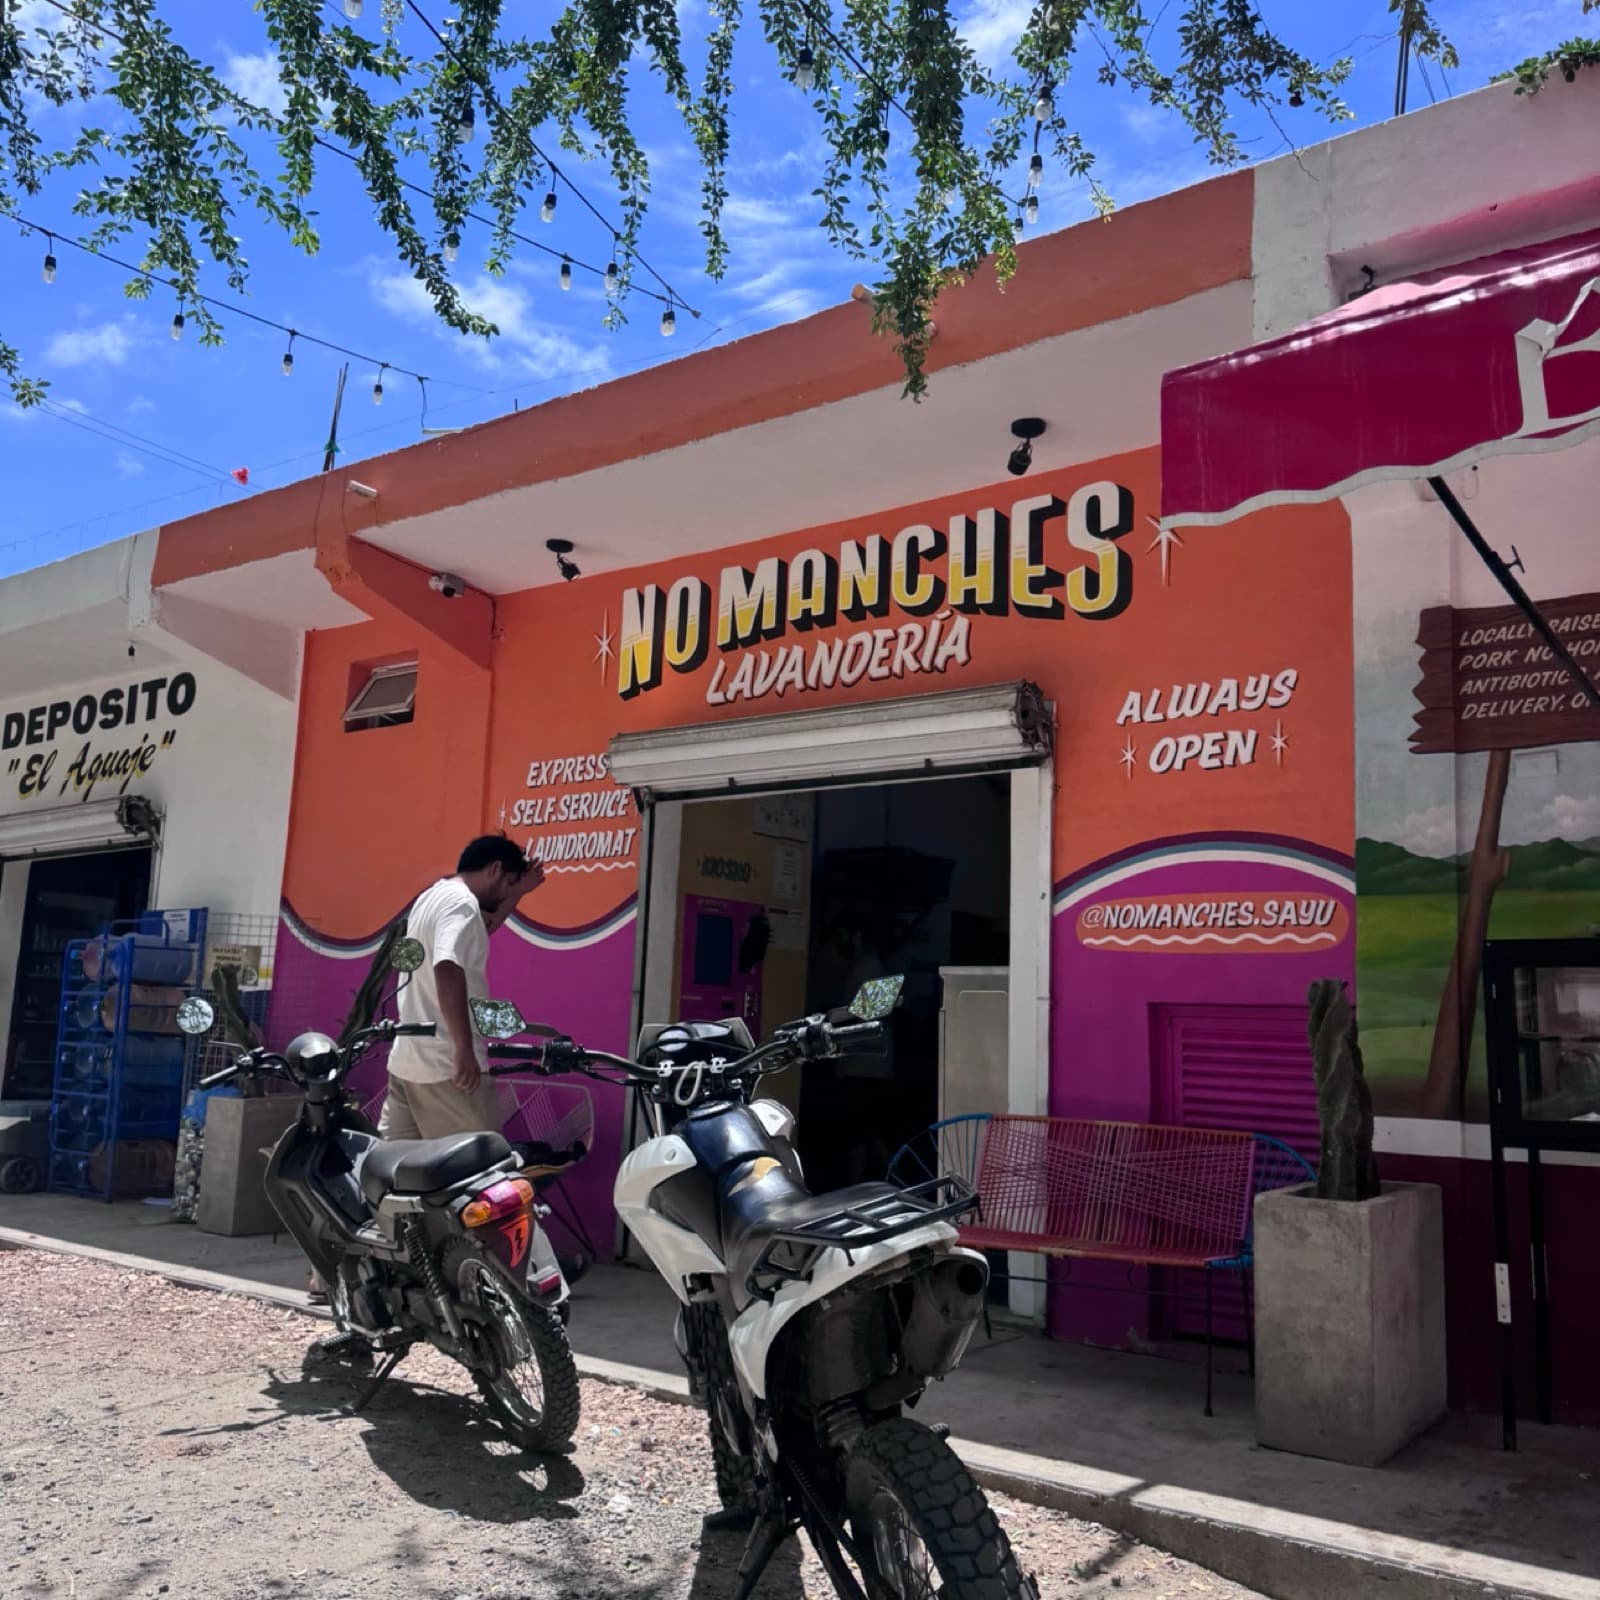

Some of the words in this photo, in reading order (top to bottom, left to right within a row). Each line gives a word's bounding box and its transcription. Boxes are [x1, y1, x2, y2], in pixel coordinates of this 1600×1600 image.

[617, 576, 710, 699] NO
[716, 480, 1135, 653] MANCHES
[1459, 623, 1536, 647] LOCALLY
[705, 609, 971, 705] LAVANDERÍA
[1458, 649, 1518, 671] PORK
[1116, 668, 1298, 727] ALWAYS
[1458, 667, 1587, 696] ANTIBIOTIC
[1, 672, 197, 750] DEPOSITO
[526, 752, 609, 788] EXPRESS
[1148, 729, 1258, 774] OPEN
[524, 827, 637, 863] LAUNDROMAT
